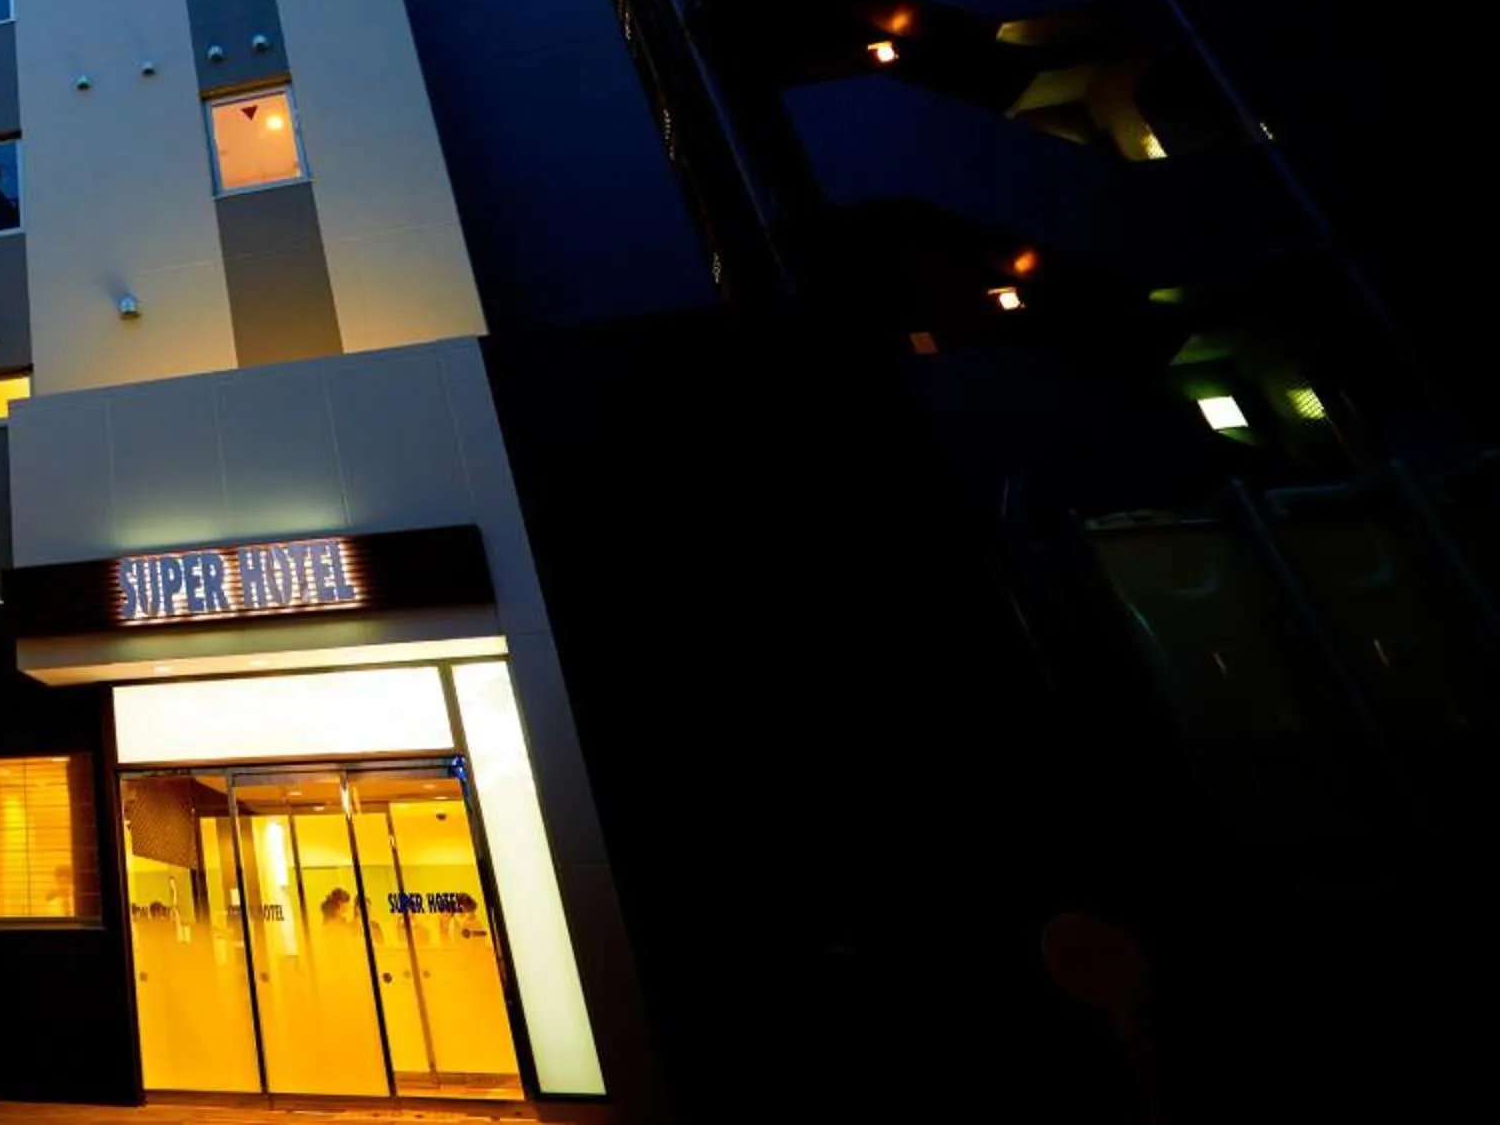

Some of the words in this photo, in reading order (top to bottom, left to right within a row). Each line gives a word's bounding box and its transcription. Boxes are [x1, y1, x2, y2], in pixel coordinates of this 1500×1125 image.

[119, 552, 229, 620] SUPER
[237, 539, 356, 608] HOTEL
[387, 892, 425, 914] SUPER
[426, 892, 463, 914] HOTEL
